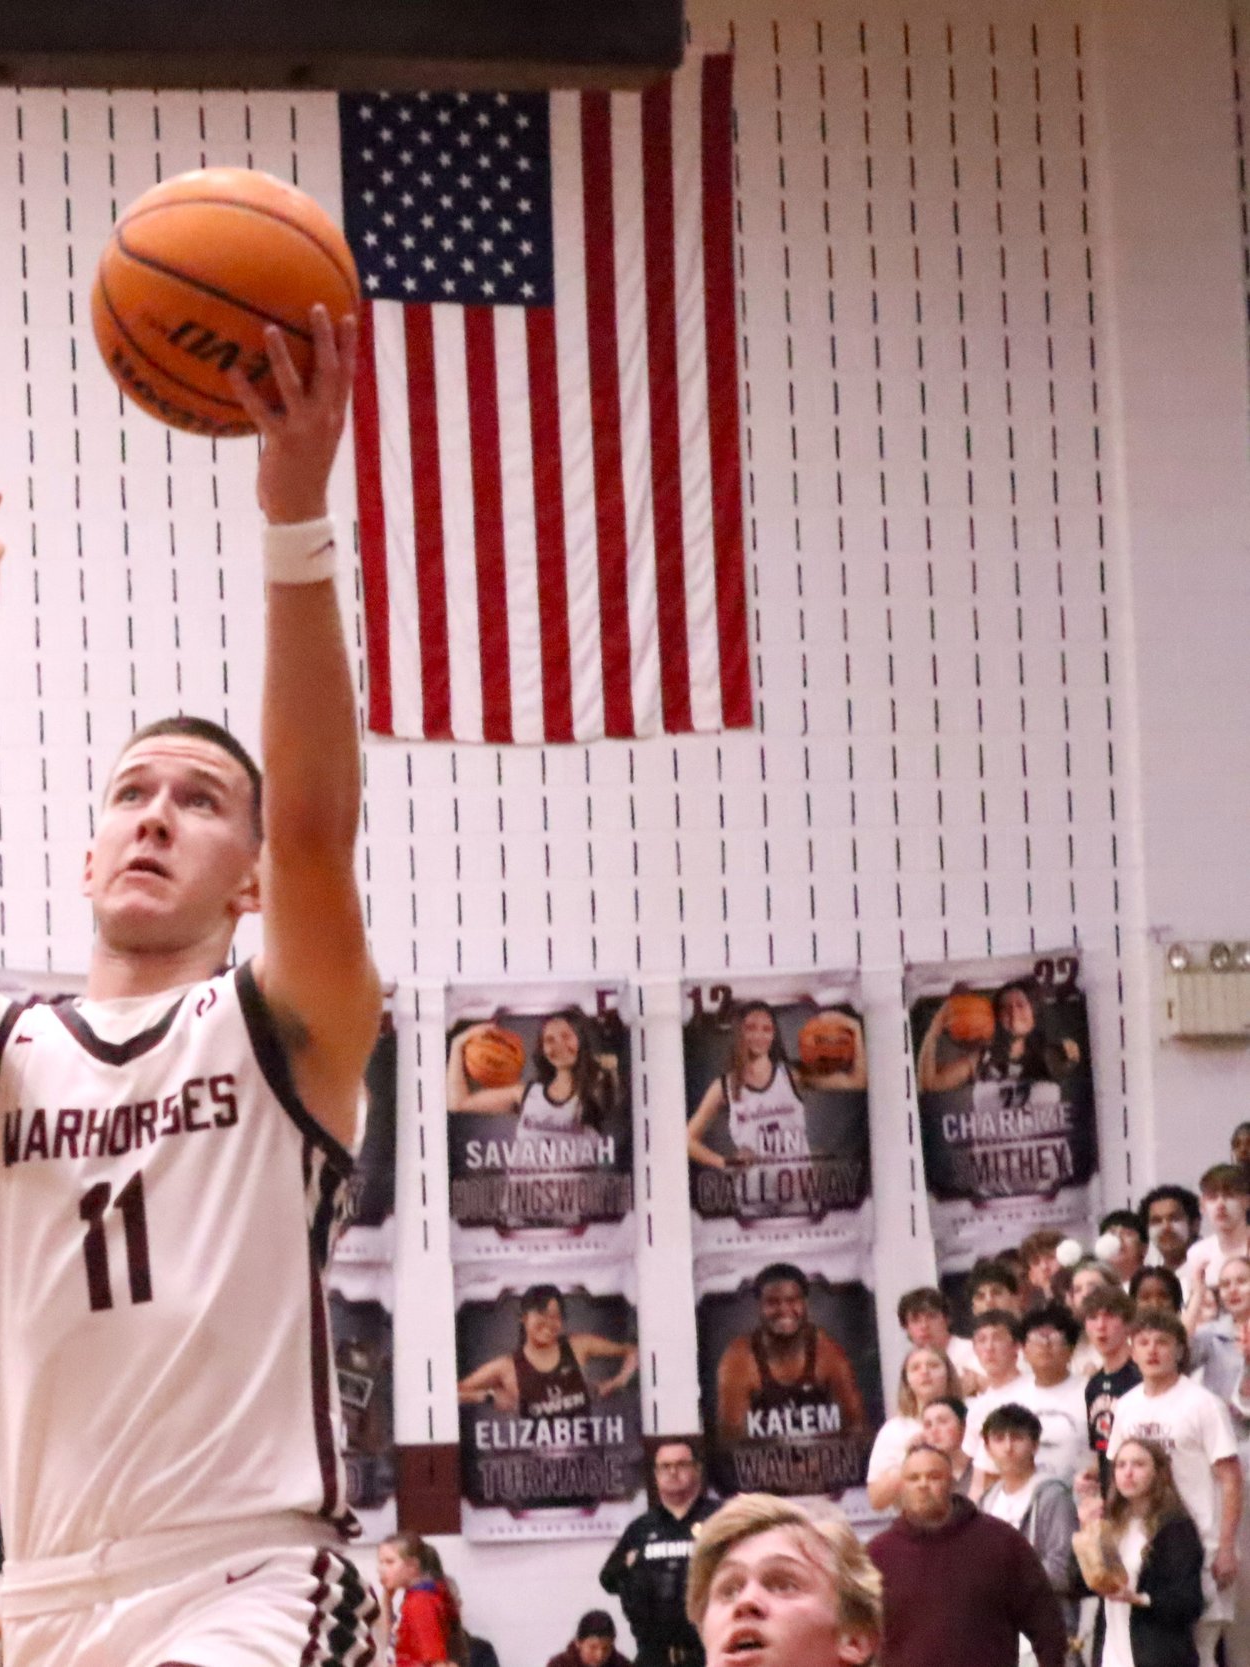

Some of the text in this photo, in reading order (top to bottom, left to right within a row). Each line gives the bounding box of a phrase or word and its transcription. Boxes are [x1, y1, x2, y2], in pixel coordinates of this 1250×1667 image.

[466, 1135, 616, 1169] SAVANNAH
[79, 1170, 154, 1313] 11
[475, 1414, 625, 1450] ELIZABETH
[746, 1402, 842, 1438] KALEM
